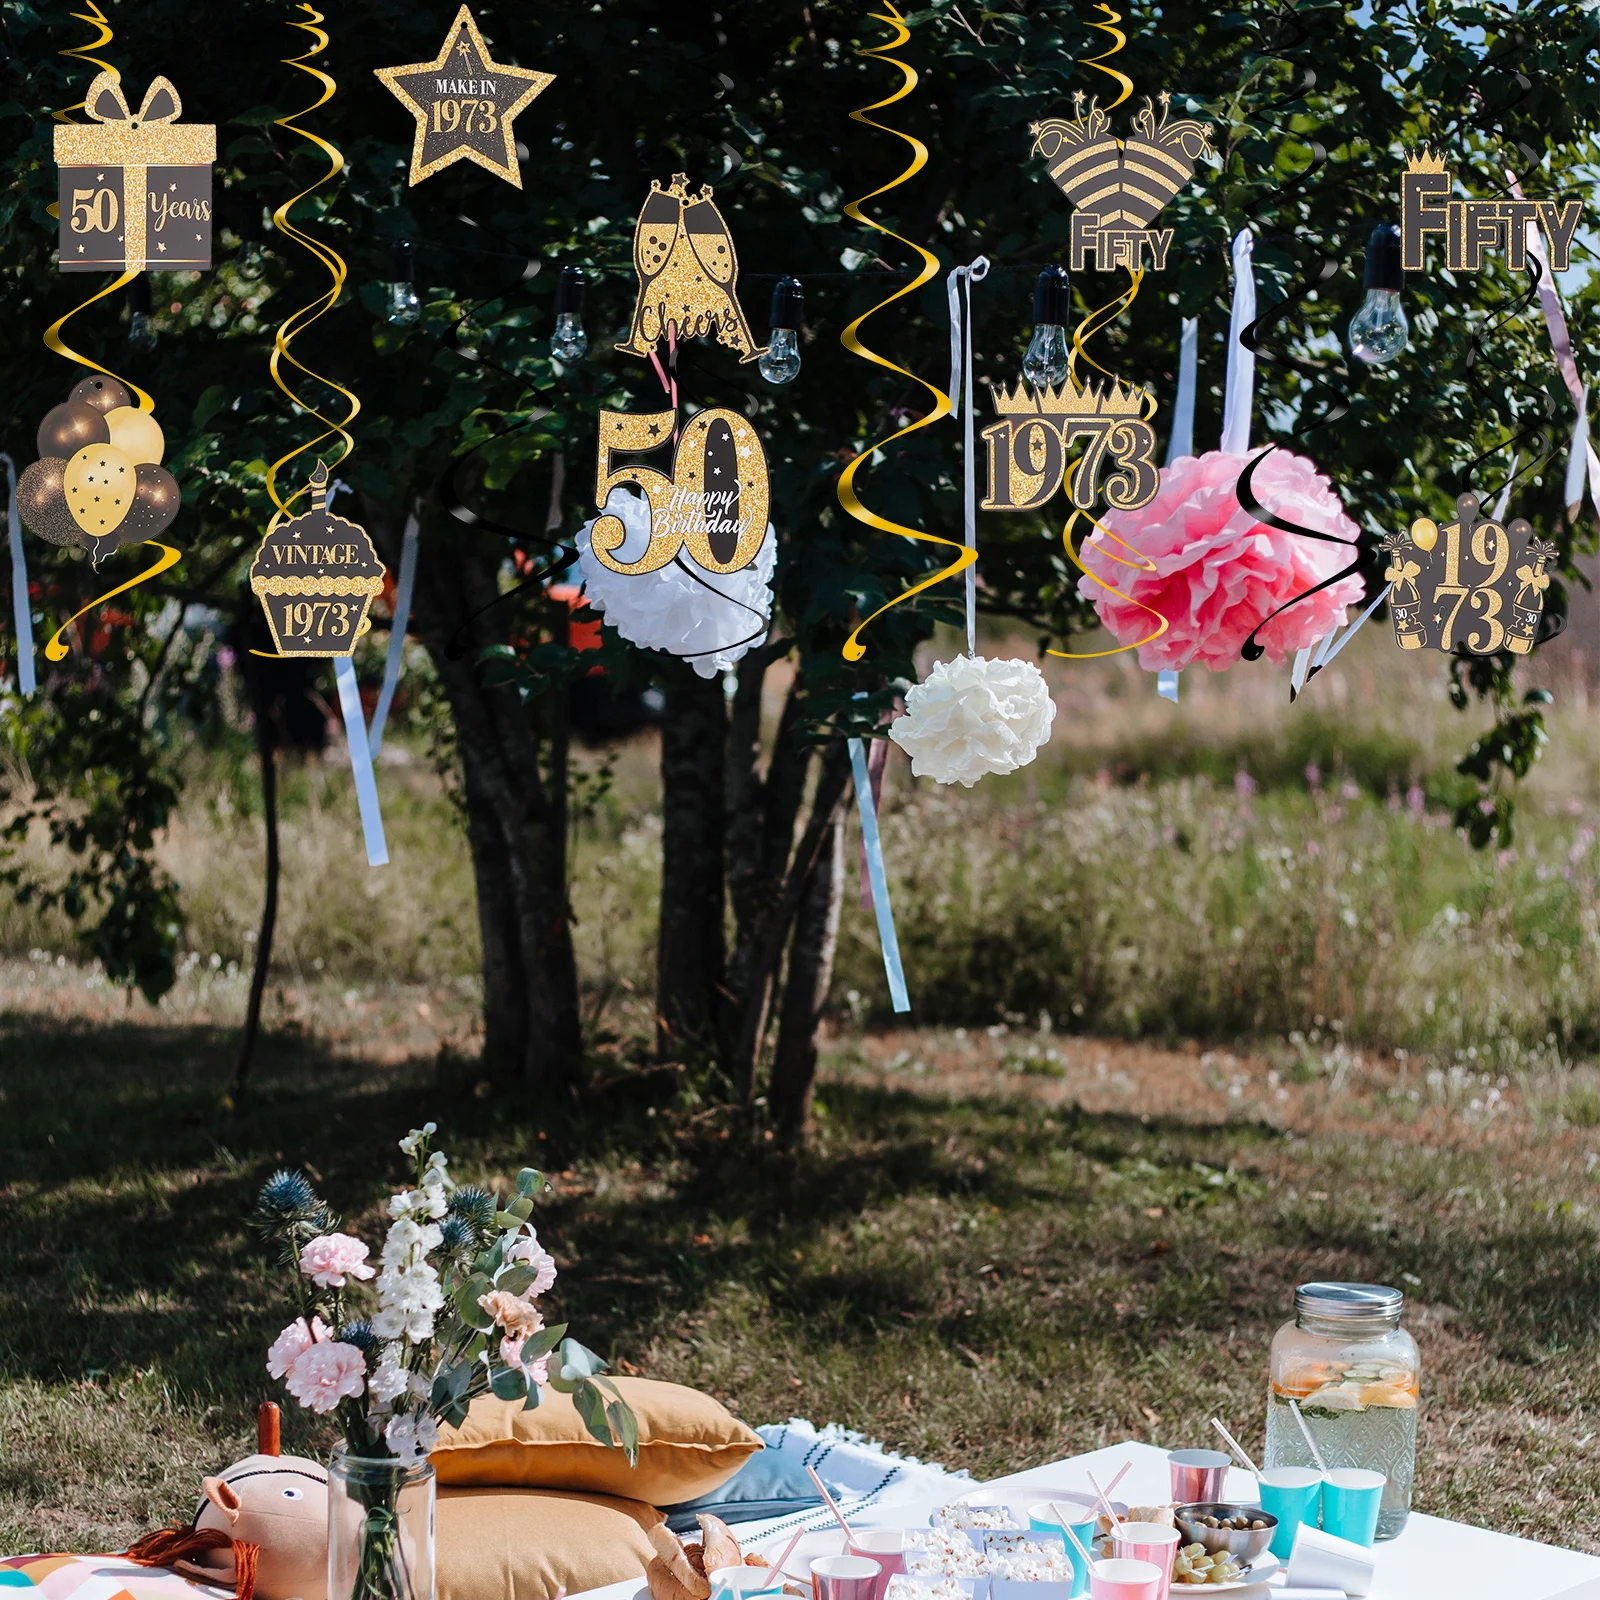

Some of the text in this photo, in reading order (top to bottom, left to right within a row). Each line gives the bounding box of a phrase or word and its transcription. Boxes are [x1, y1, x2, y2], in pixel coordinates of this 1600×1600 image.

[435, 79, 497, 96] MAKE IN
[431, 99, 498, 134] 1973
[70, 187, 212, 234] 50 Years
[640, 301, 740, 342] Cheers
[980, 416, 1160, 511] 1973
[590, 407, 771, 575] 50
[667, 478, 742, 515] Happy
[650, 505, 753, 545] Birthday
[270, 543, 360, 565] VINTAGE
[1440, 522, 1510, 588] 19
[281, 602, 351, 638] 1973
[1394, 607, 1409, 621] 30
[1432, 587, 1505, 653] 73
[1524, 611, 1538, 624] 30
